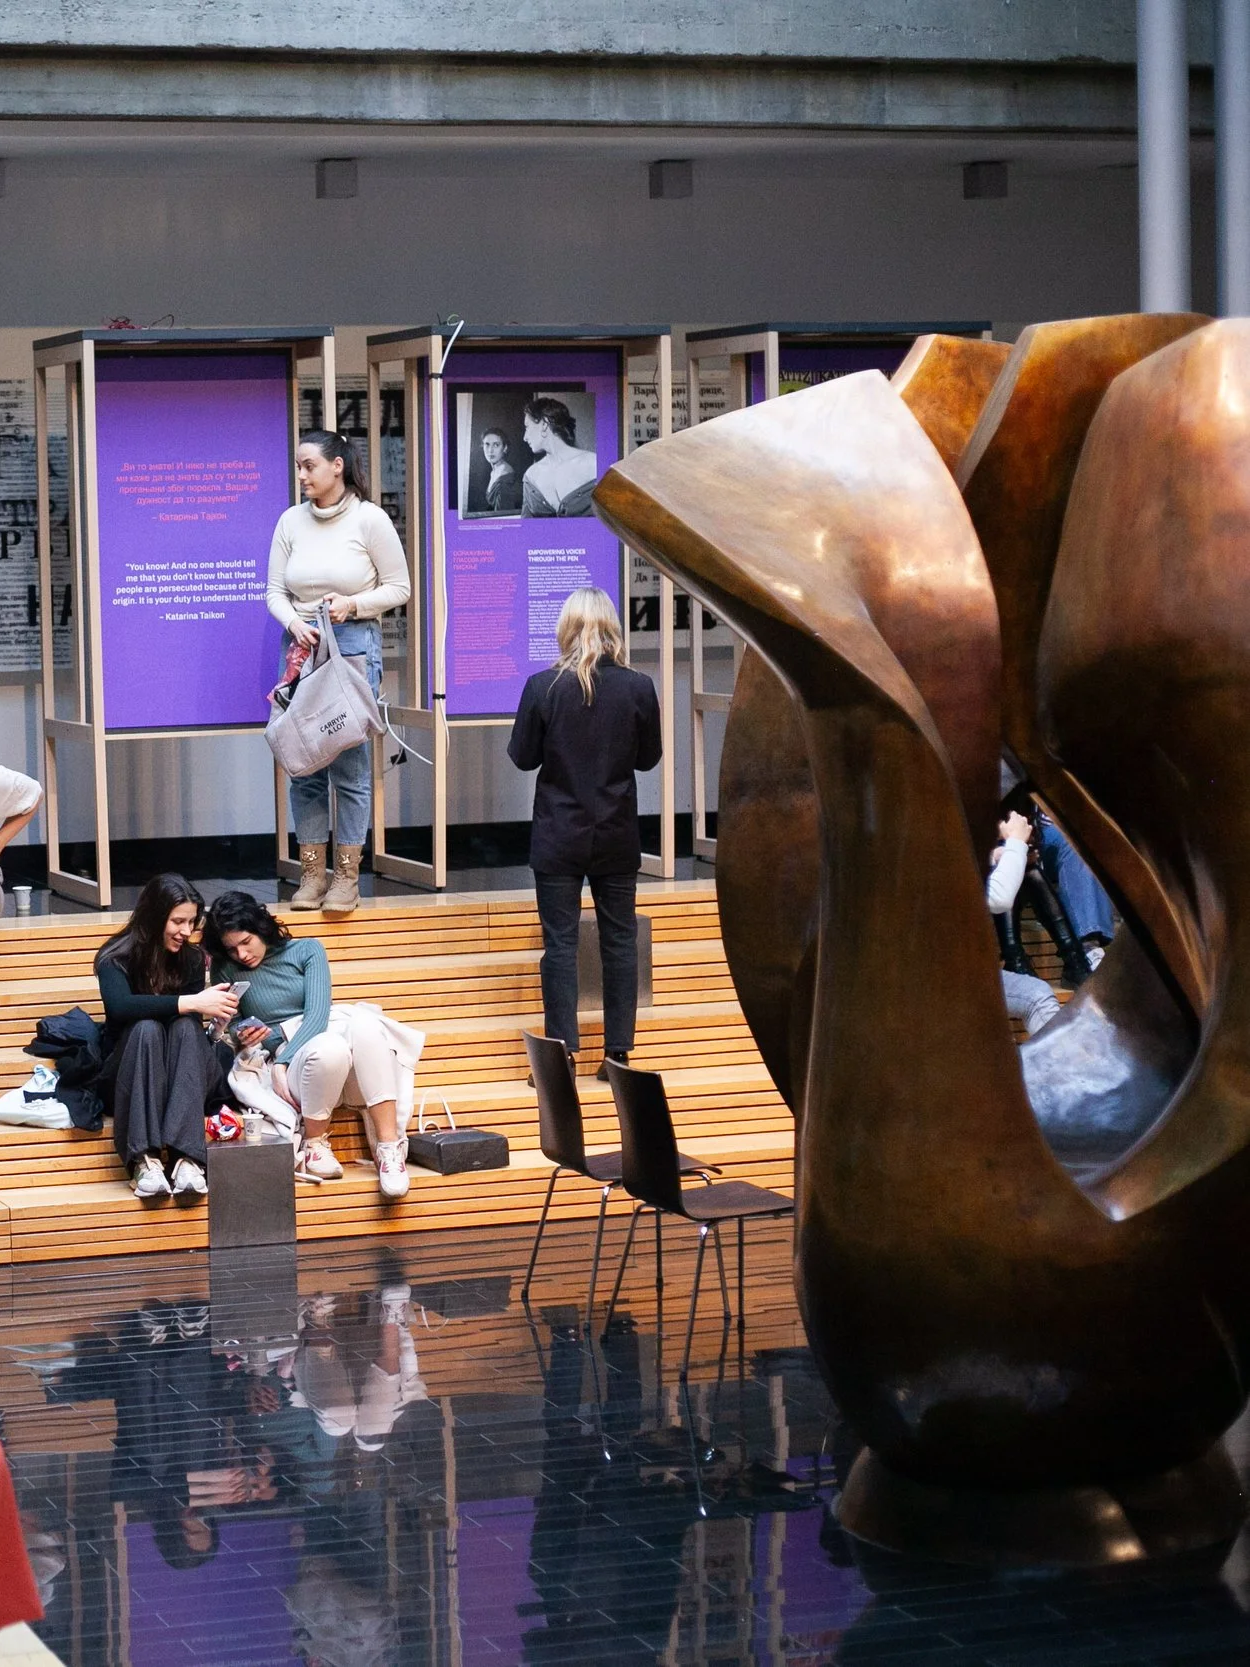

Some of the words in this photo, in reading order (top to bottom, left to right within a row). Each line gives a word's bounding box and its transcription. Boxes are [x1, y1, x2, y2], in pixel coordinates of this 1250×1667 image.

[146, 562, 169, 570] know!
[116, 586, 142, 595] people
[159, 584, 202, 593] persecuted
[204, 583, 236, 591] because
[238, 582, 246, 590] of
[113, 597, 137, 606] origin.
[147, 596, 151, 604] is
[155, 596, 172, 604] your
[174, 595, 190, 604] duty
[202, 594, 246, 602] understand
[333, 721, 346, 732] LOT
